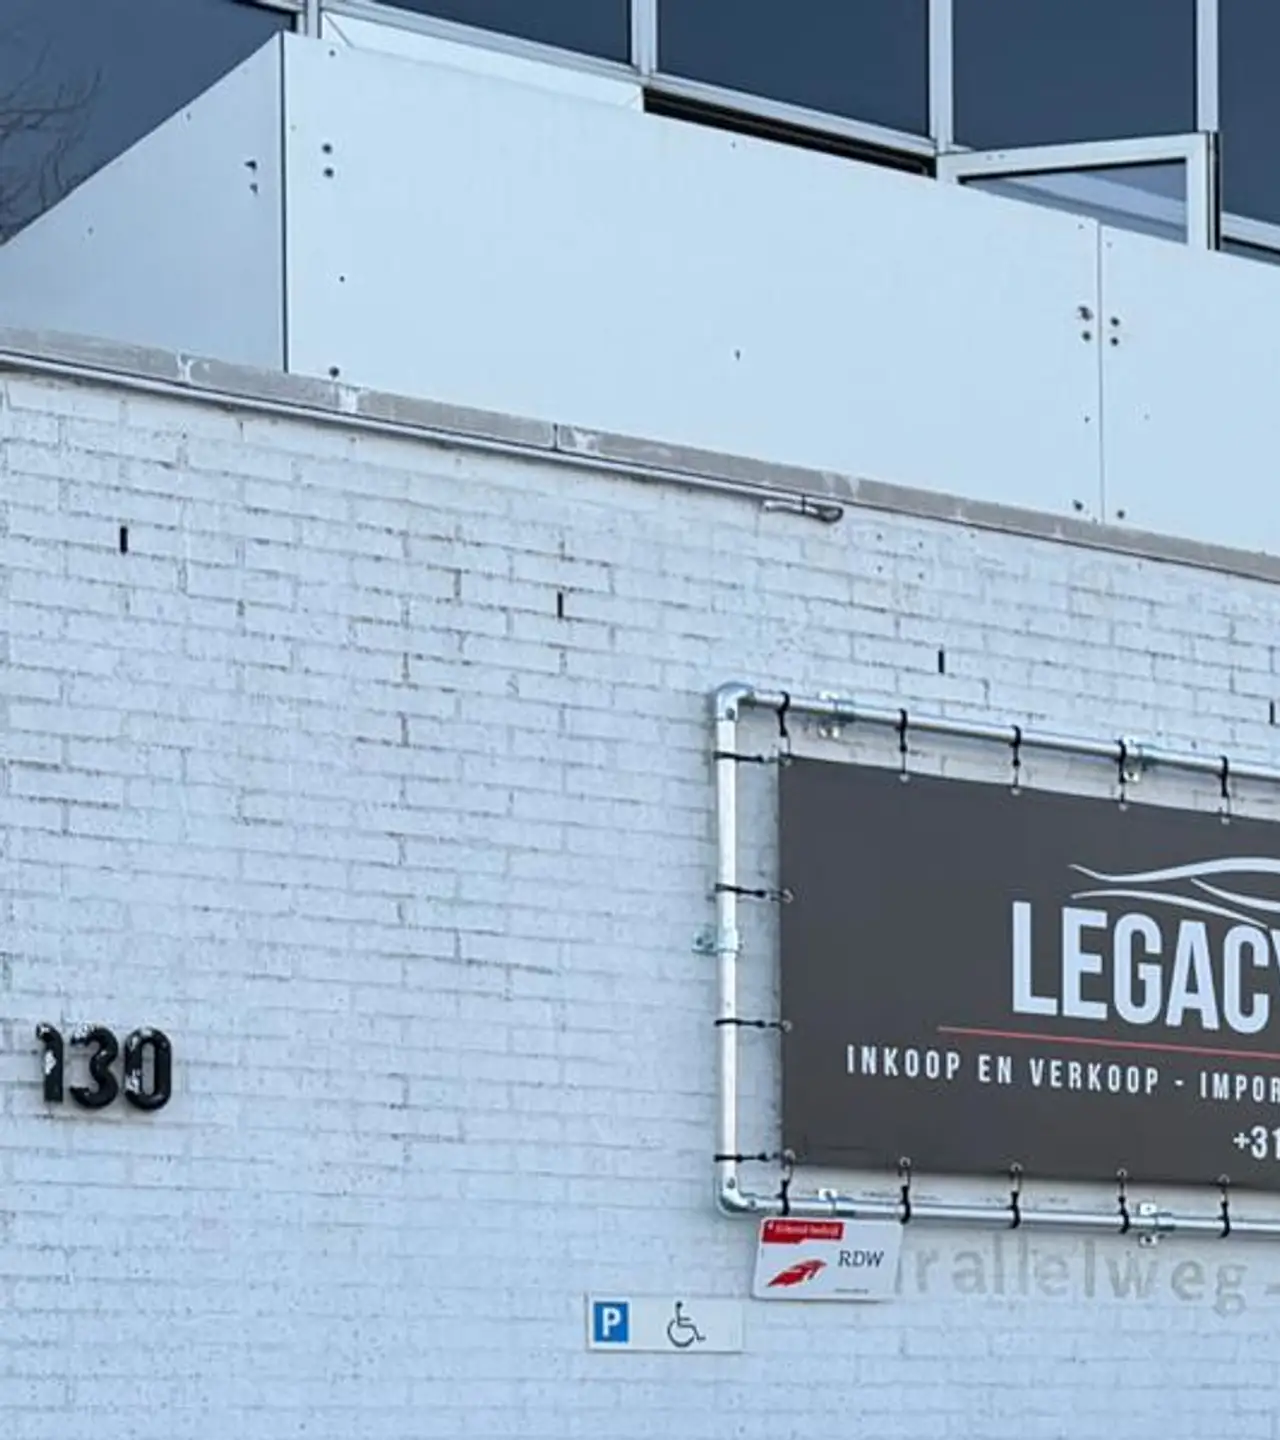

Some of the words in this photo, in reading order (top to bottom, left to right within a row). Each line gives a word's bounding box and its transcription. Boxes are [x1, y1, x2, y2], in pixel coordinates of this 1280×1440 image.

[36, 1022, 172, 1113] 130
[846, 1043, 961, 1081] INKOOP
[978, 1053, 1012, 1085] EN
[1029, 1058, 1159, 1096] VERKOOP
[837, 1249, 886, 1269] RDW
[602, 1306, 621, 1337] P
